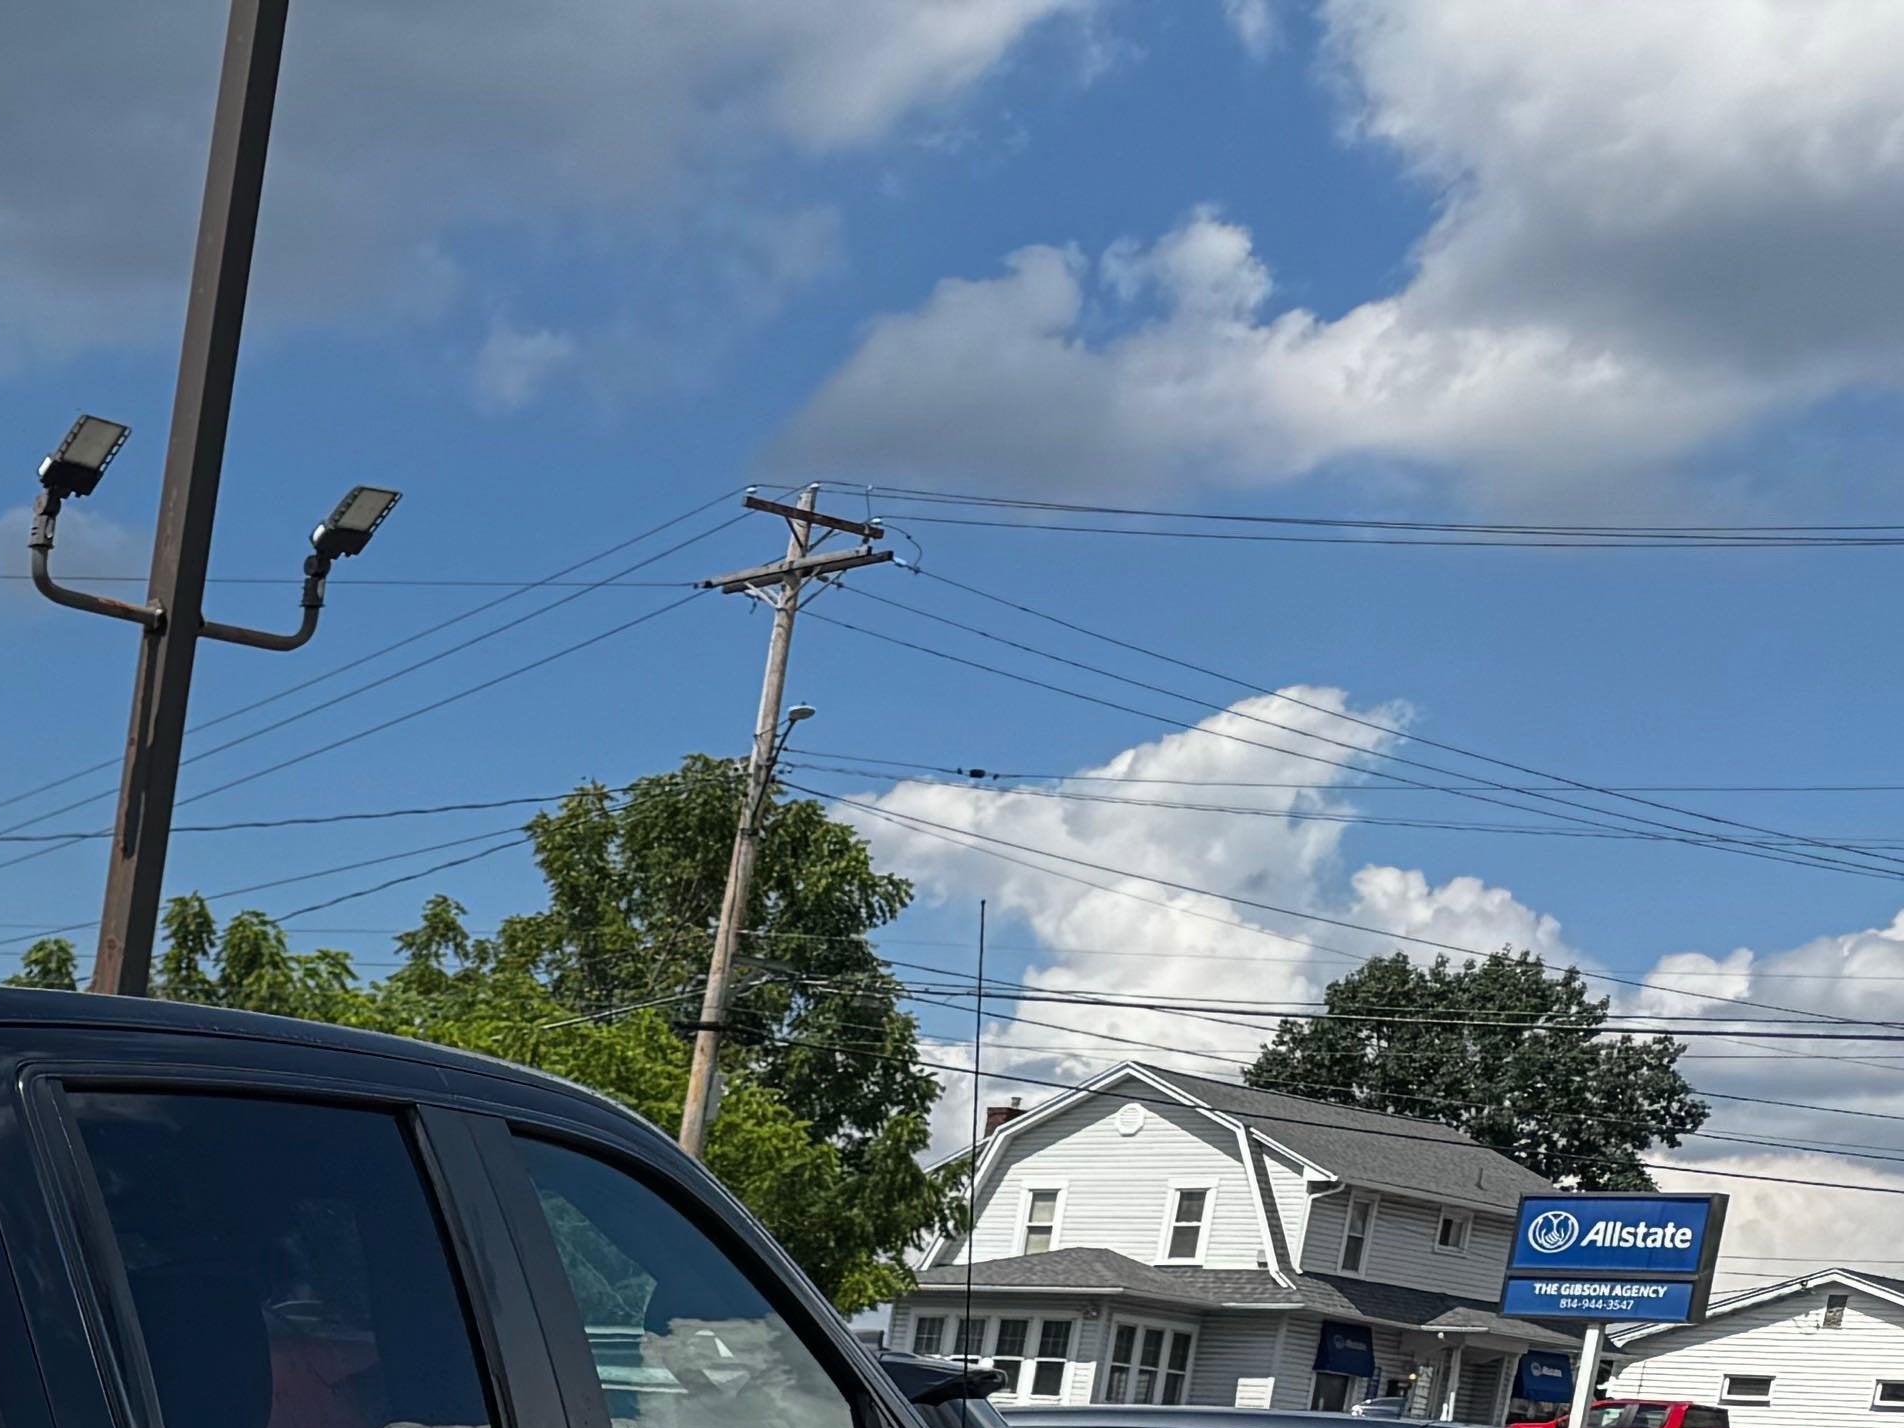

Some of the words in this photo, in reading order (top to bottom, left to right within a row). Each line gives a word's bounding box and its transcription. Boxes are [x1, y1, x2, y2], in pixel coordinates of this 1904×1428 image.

[1580, 1221, 1692, 1249] Allstate
[1533, 1283, 1559, 1296] THE
[1560, 1283, 1610, 1297] GIBSON
[1611, 1285, 1668, 1298] AGENCY
[1559, 1298, 1634, 1310] 814-944-3547
